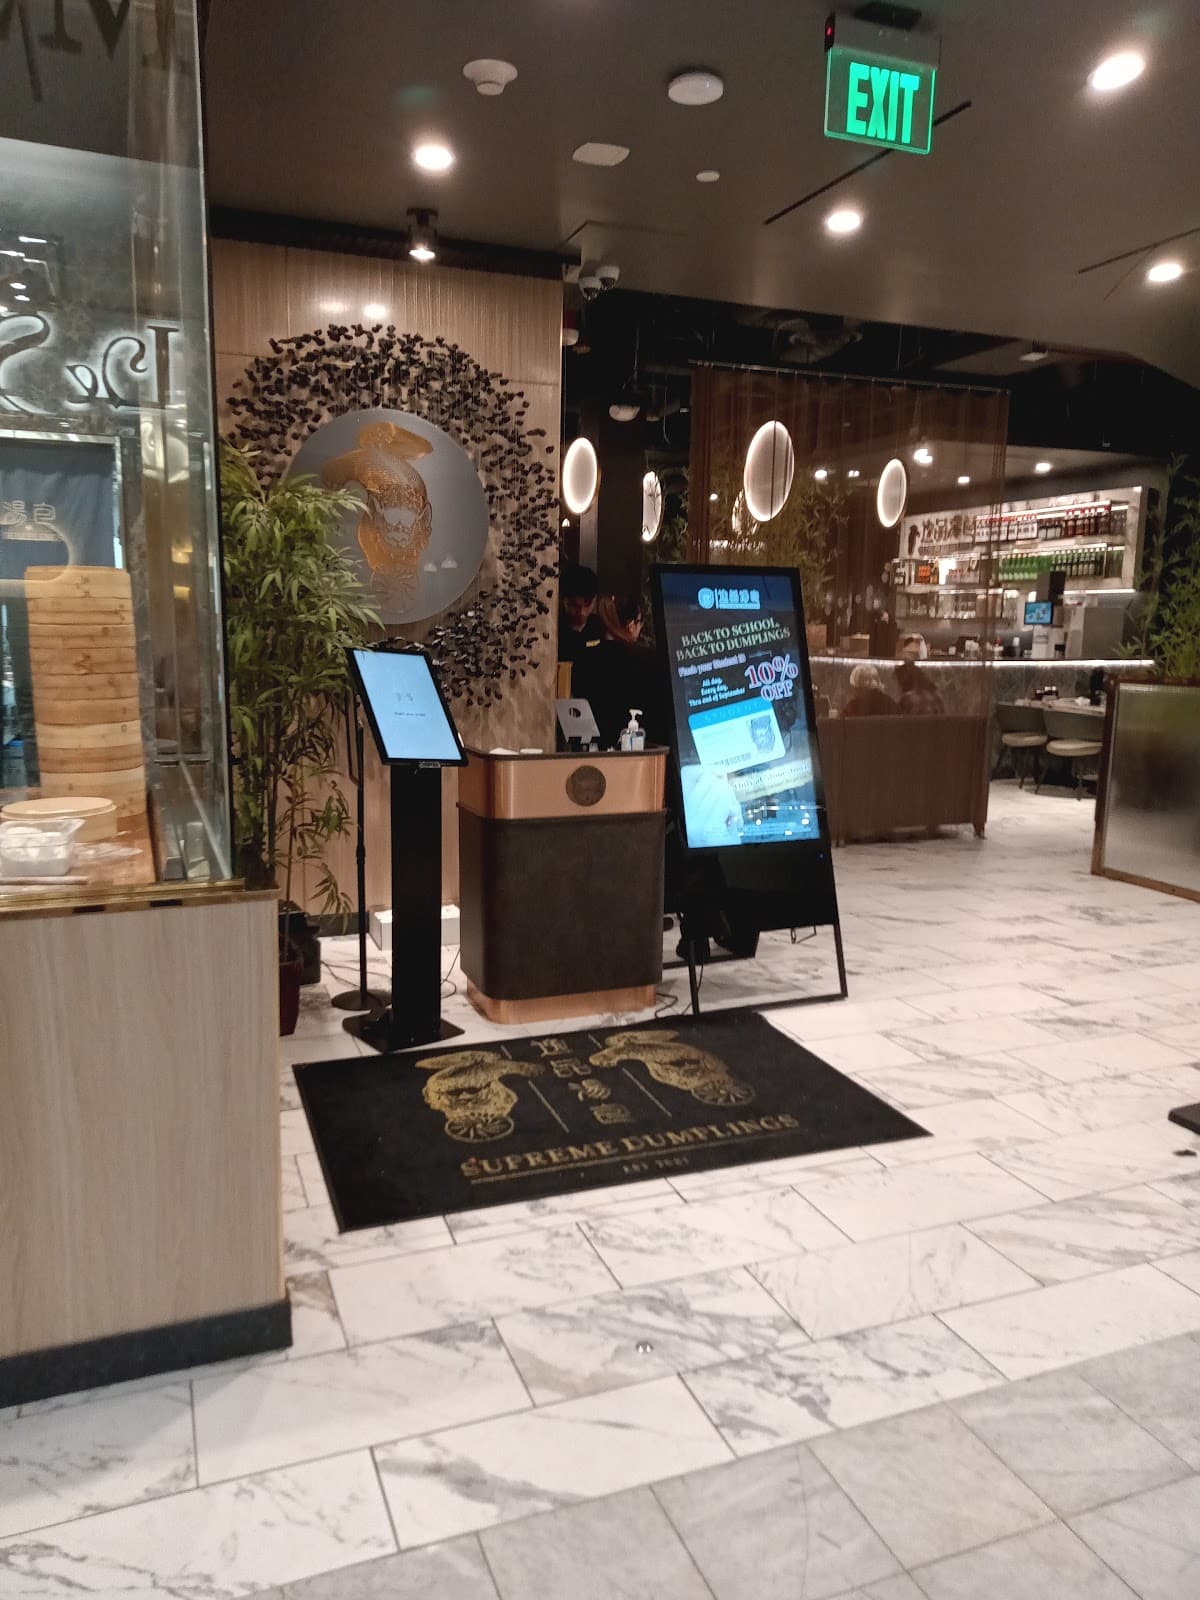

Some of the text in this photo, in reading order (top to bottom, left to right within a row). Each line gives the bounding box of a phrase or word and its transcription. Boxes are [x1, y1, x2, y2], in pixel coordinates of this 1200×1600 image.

[846, 62, 920, 144] EXIT
[675, 627, 791, 660] BACK TO DUMPLINGS
[681, 630, 713, 647] BACK
[713, 627, 730, 640] TO
[744, 653, 798, 689] 10%
[761, 679, 794, 701] OFF
[460, 1113, 800, 1177] SUPREME DUMPLINGS
